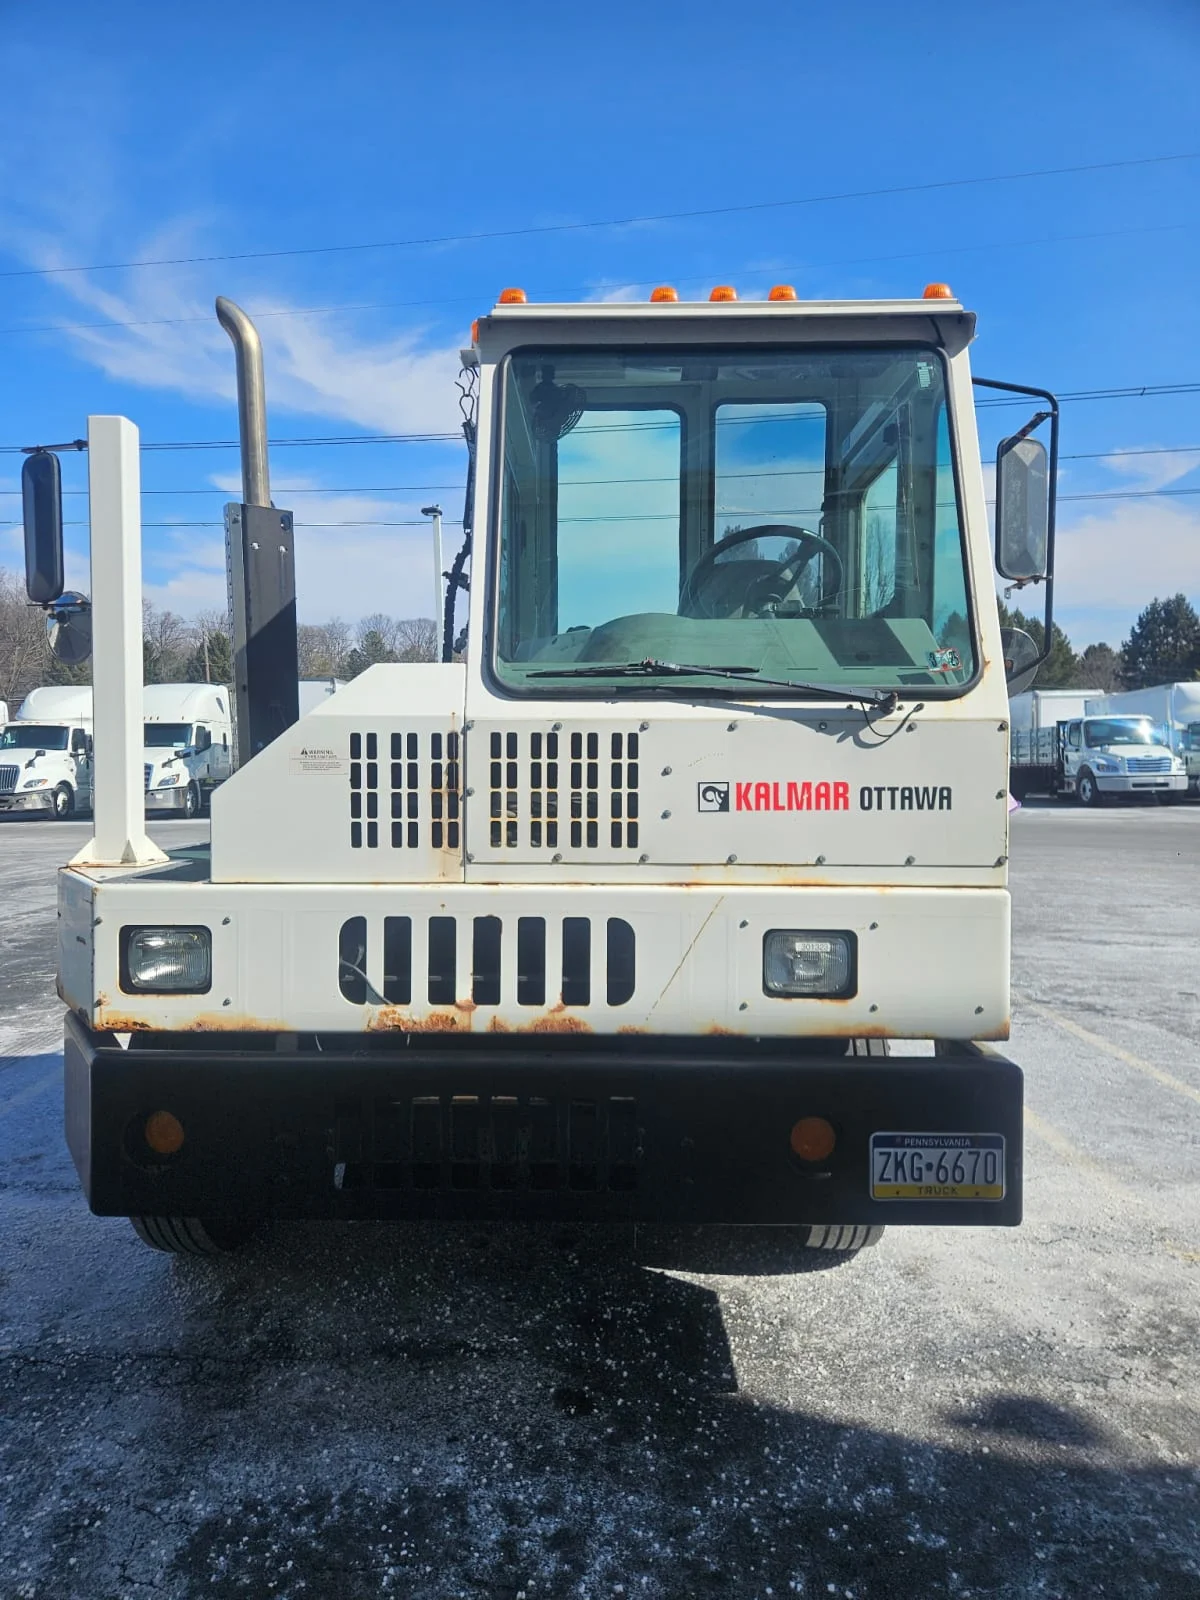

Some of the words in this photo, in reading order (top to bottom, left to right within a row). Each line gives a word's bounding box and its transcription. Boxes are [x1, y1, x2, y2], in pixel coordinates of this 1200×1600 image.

[735, 781, 849, 811] KALMAR
[859, 786, 952, 811] OTTAWA
[904, 1137, 972, 1147] PENNSYLVANIA
[917, 1185, 960, 1196] TRUCK
